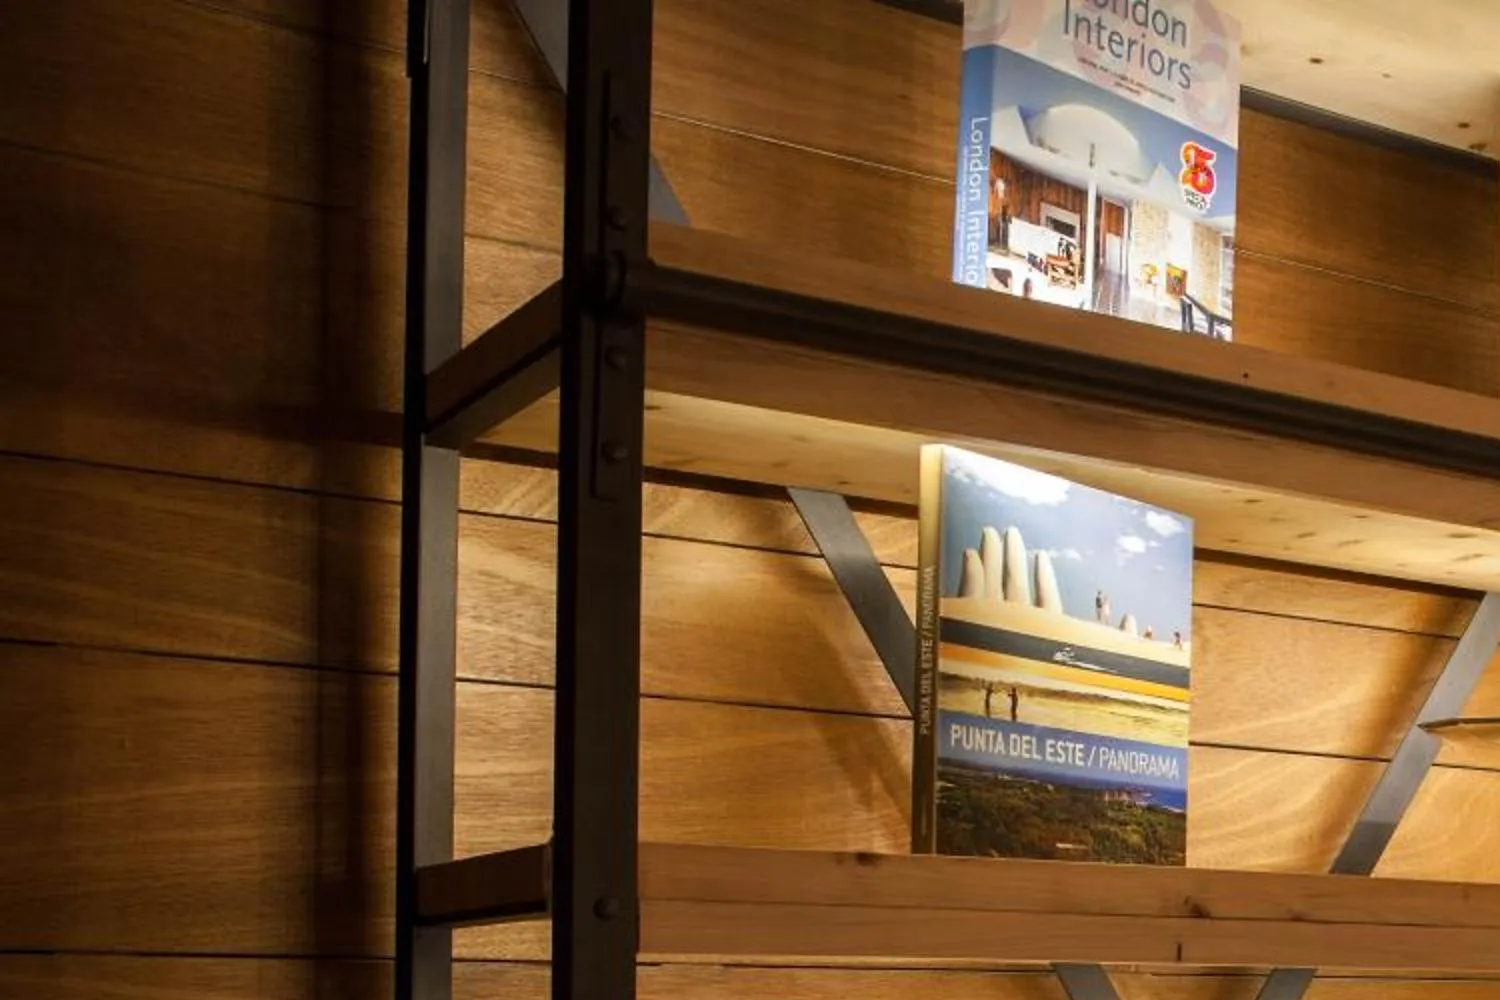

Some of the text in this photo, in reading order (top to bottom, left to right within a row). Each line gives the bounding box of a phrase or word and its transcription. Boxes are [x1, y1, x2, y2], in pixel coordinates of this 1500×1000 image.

[1064, 0, 1192, 90] Interiors
[969, 117, 989, 200] London
[920, 697, 932, 735] PUNTA
[950, 725, 1006, 752] PUNTA
[1009, 732, 1042, 760] DEL
[1045, 739, 1085, 766] ESTE
[1099, 746, 1180, 780] PANORAMA
